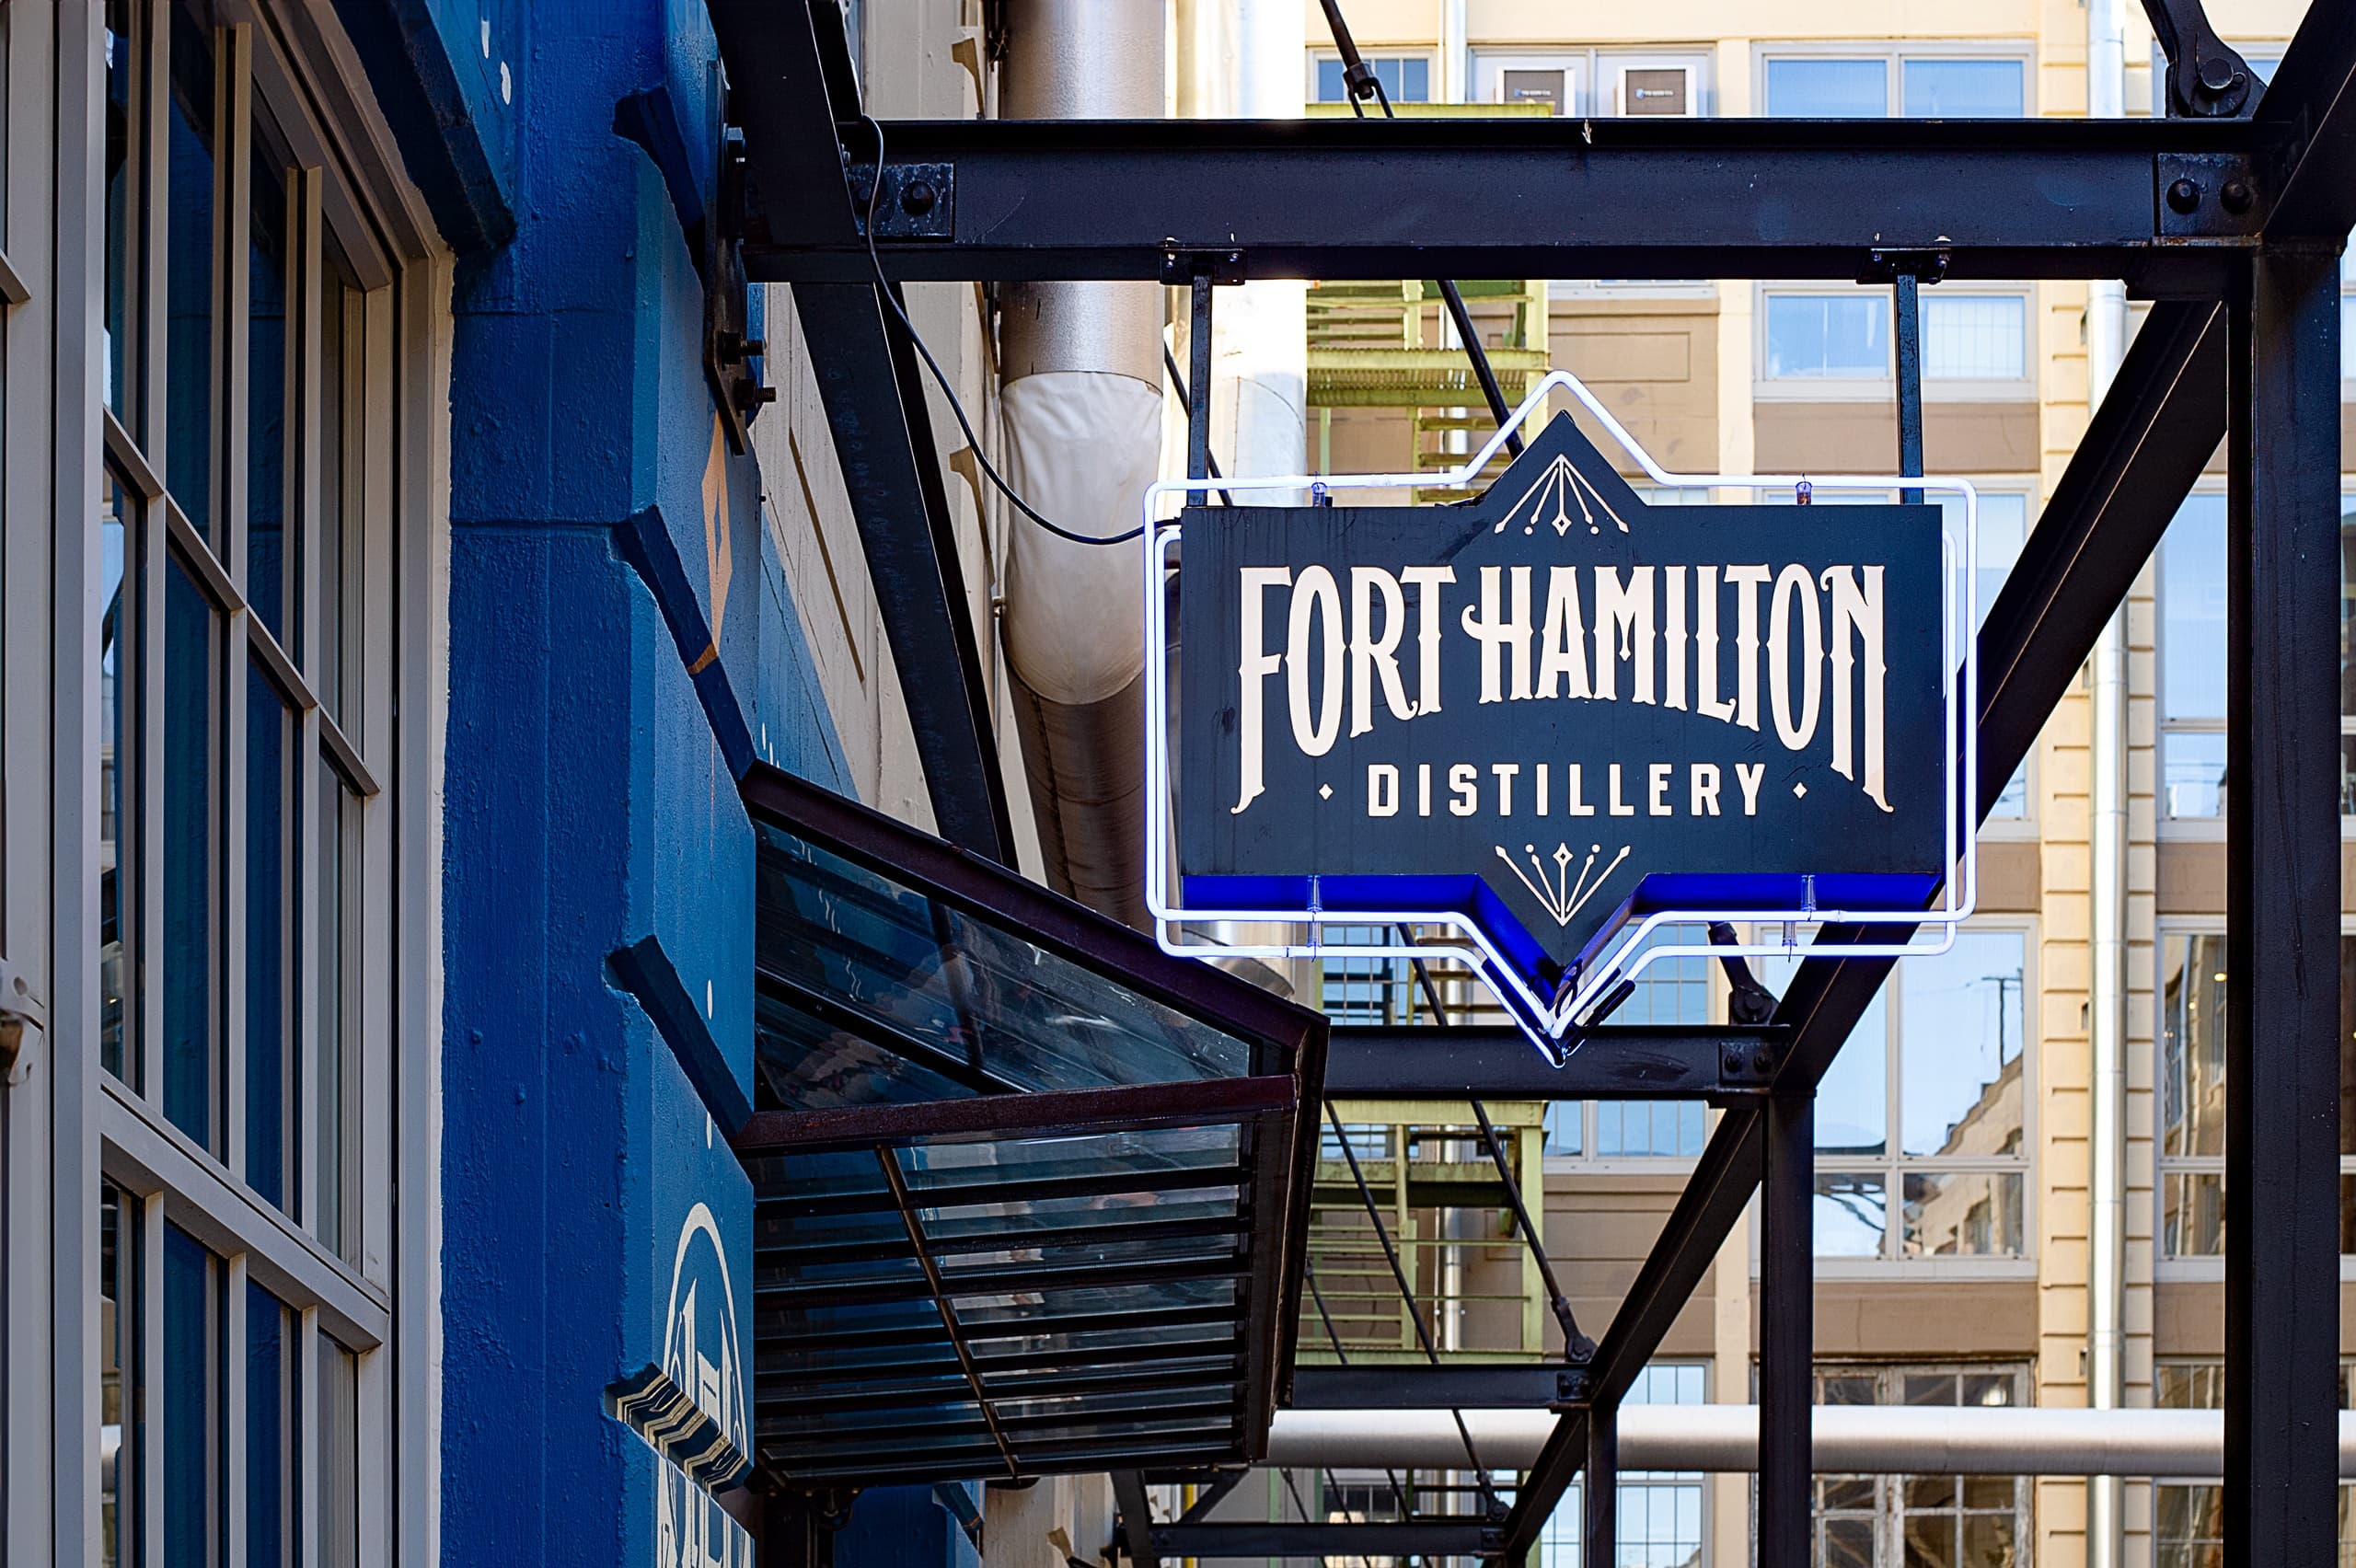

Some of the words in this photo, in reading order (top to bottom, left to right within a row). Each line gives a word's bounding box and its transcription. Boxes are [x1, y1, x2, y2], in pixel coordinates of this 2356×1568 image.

[1230, 565, 1457, 814] FORT
[1461, 563, 1894, 813] HAMILTON
[1368, 763, 1766, 817] DISTILLERY
